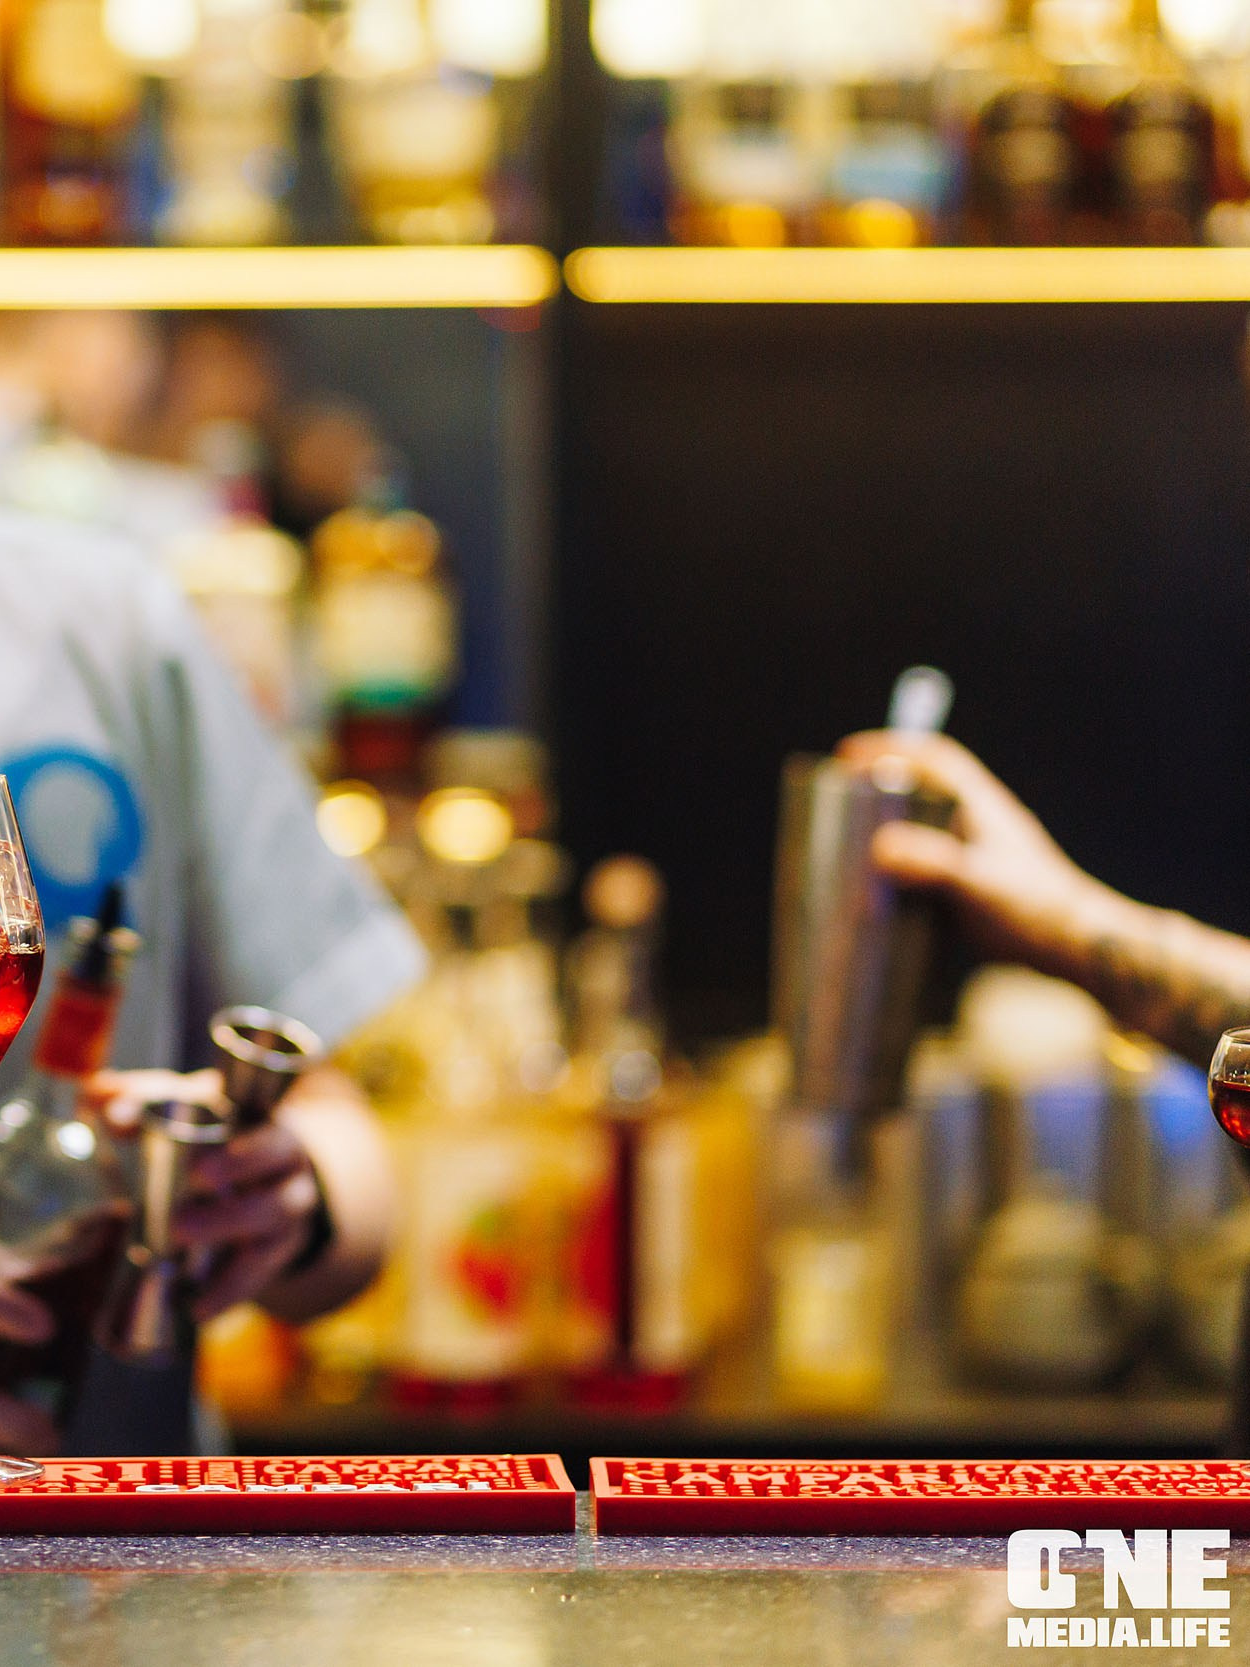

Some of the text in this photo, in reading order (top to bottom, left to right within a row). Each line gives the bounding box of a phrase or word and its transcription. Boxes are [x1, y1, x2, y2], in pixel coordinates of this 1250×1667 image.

[263, 1461, 511, 1475] CAMPARI
[974, 1465, 1208, 1475] CAMPARI
[355, 1472, 513, 1481] CAMPARI
[623, 1470, 972, 1485] CAMPARI
[136, 1482, 492, 1493] CAMPARI
[799, 1484, 1053, 1493] CAMPARI
